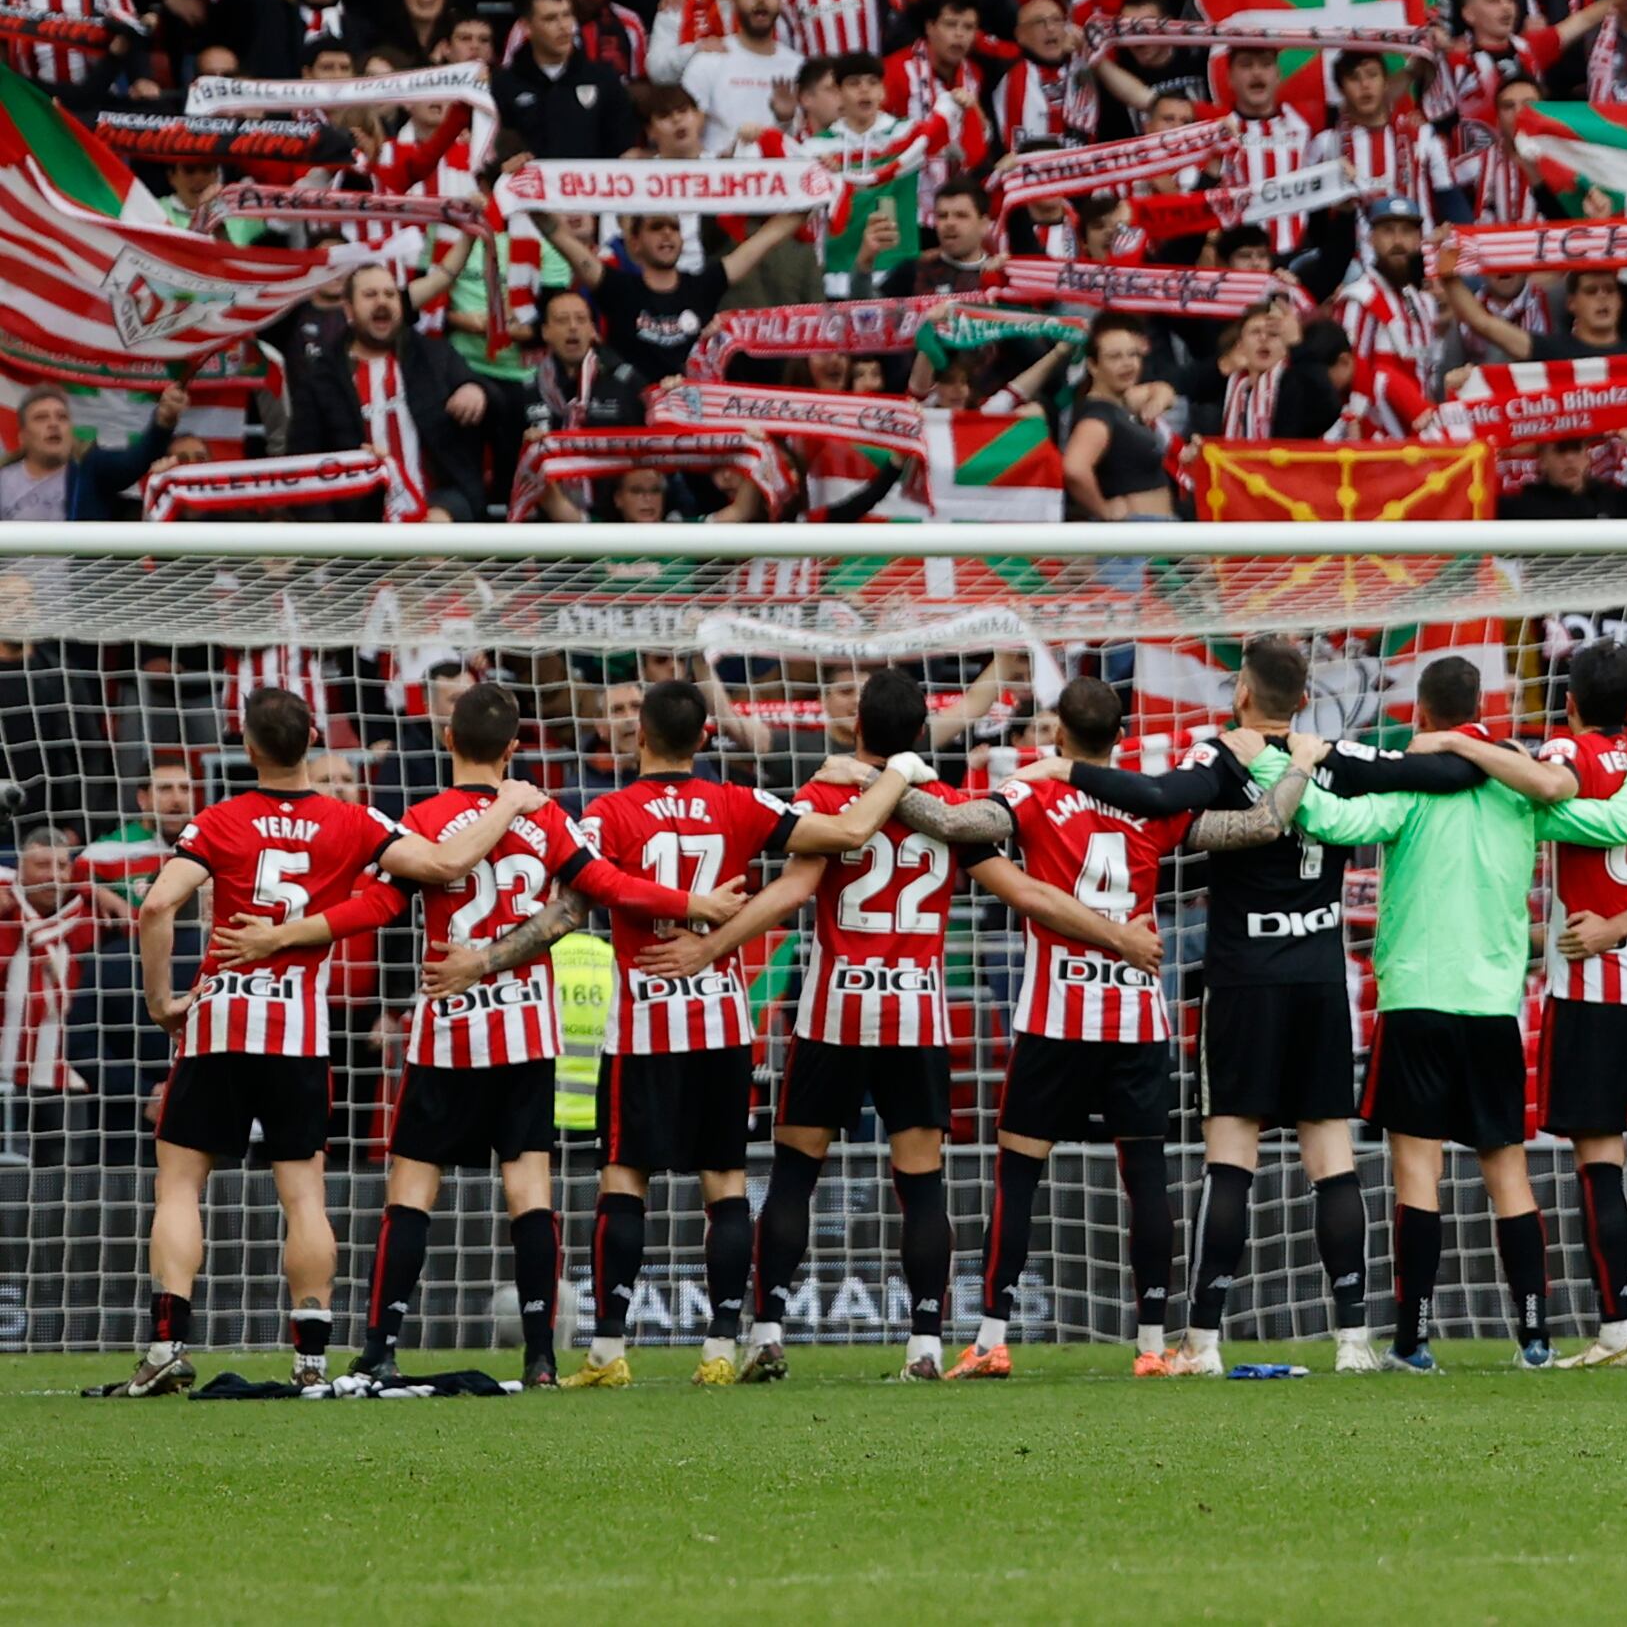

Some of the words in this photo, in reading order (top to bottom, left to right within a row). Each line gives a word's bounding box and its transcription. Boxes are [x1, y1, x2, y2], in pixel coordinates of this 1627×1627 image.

[1020, 145, 1151, 184] ATHLETIC
[1160, 120, 1229, 157] CLUB
[1260, 175, 1322, 204] CLUB
[721, 393, 853, 423] Athletic
[1506, 391, 1557, 419] Club
[252, 815, 320, 844] YERAY
[252, 847, 312, 926] 5
[641, 830, 725, 939] 17
[838, 832, 951, 934] 22
[1074, 831, 1137, 925] 4
[446, 854, 549, 953] 23
[1248, 901, 1342, 939] DIGI
[200, 974, 294, 1001] DIGI
[637, 973, 741, 1004] DIGI
[834, 966, 938, 995] DIGI
[1057, 955, 1157, 989] DIGI
[439, 978, 543, 1019] DIGI
[560, 984, 604, 1007] 166
